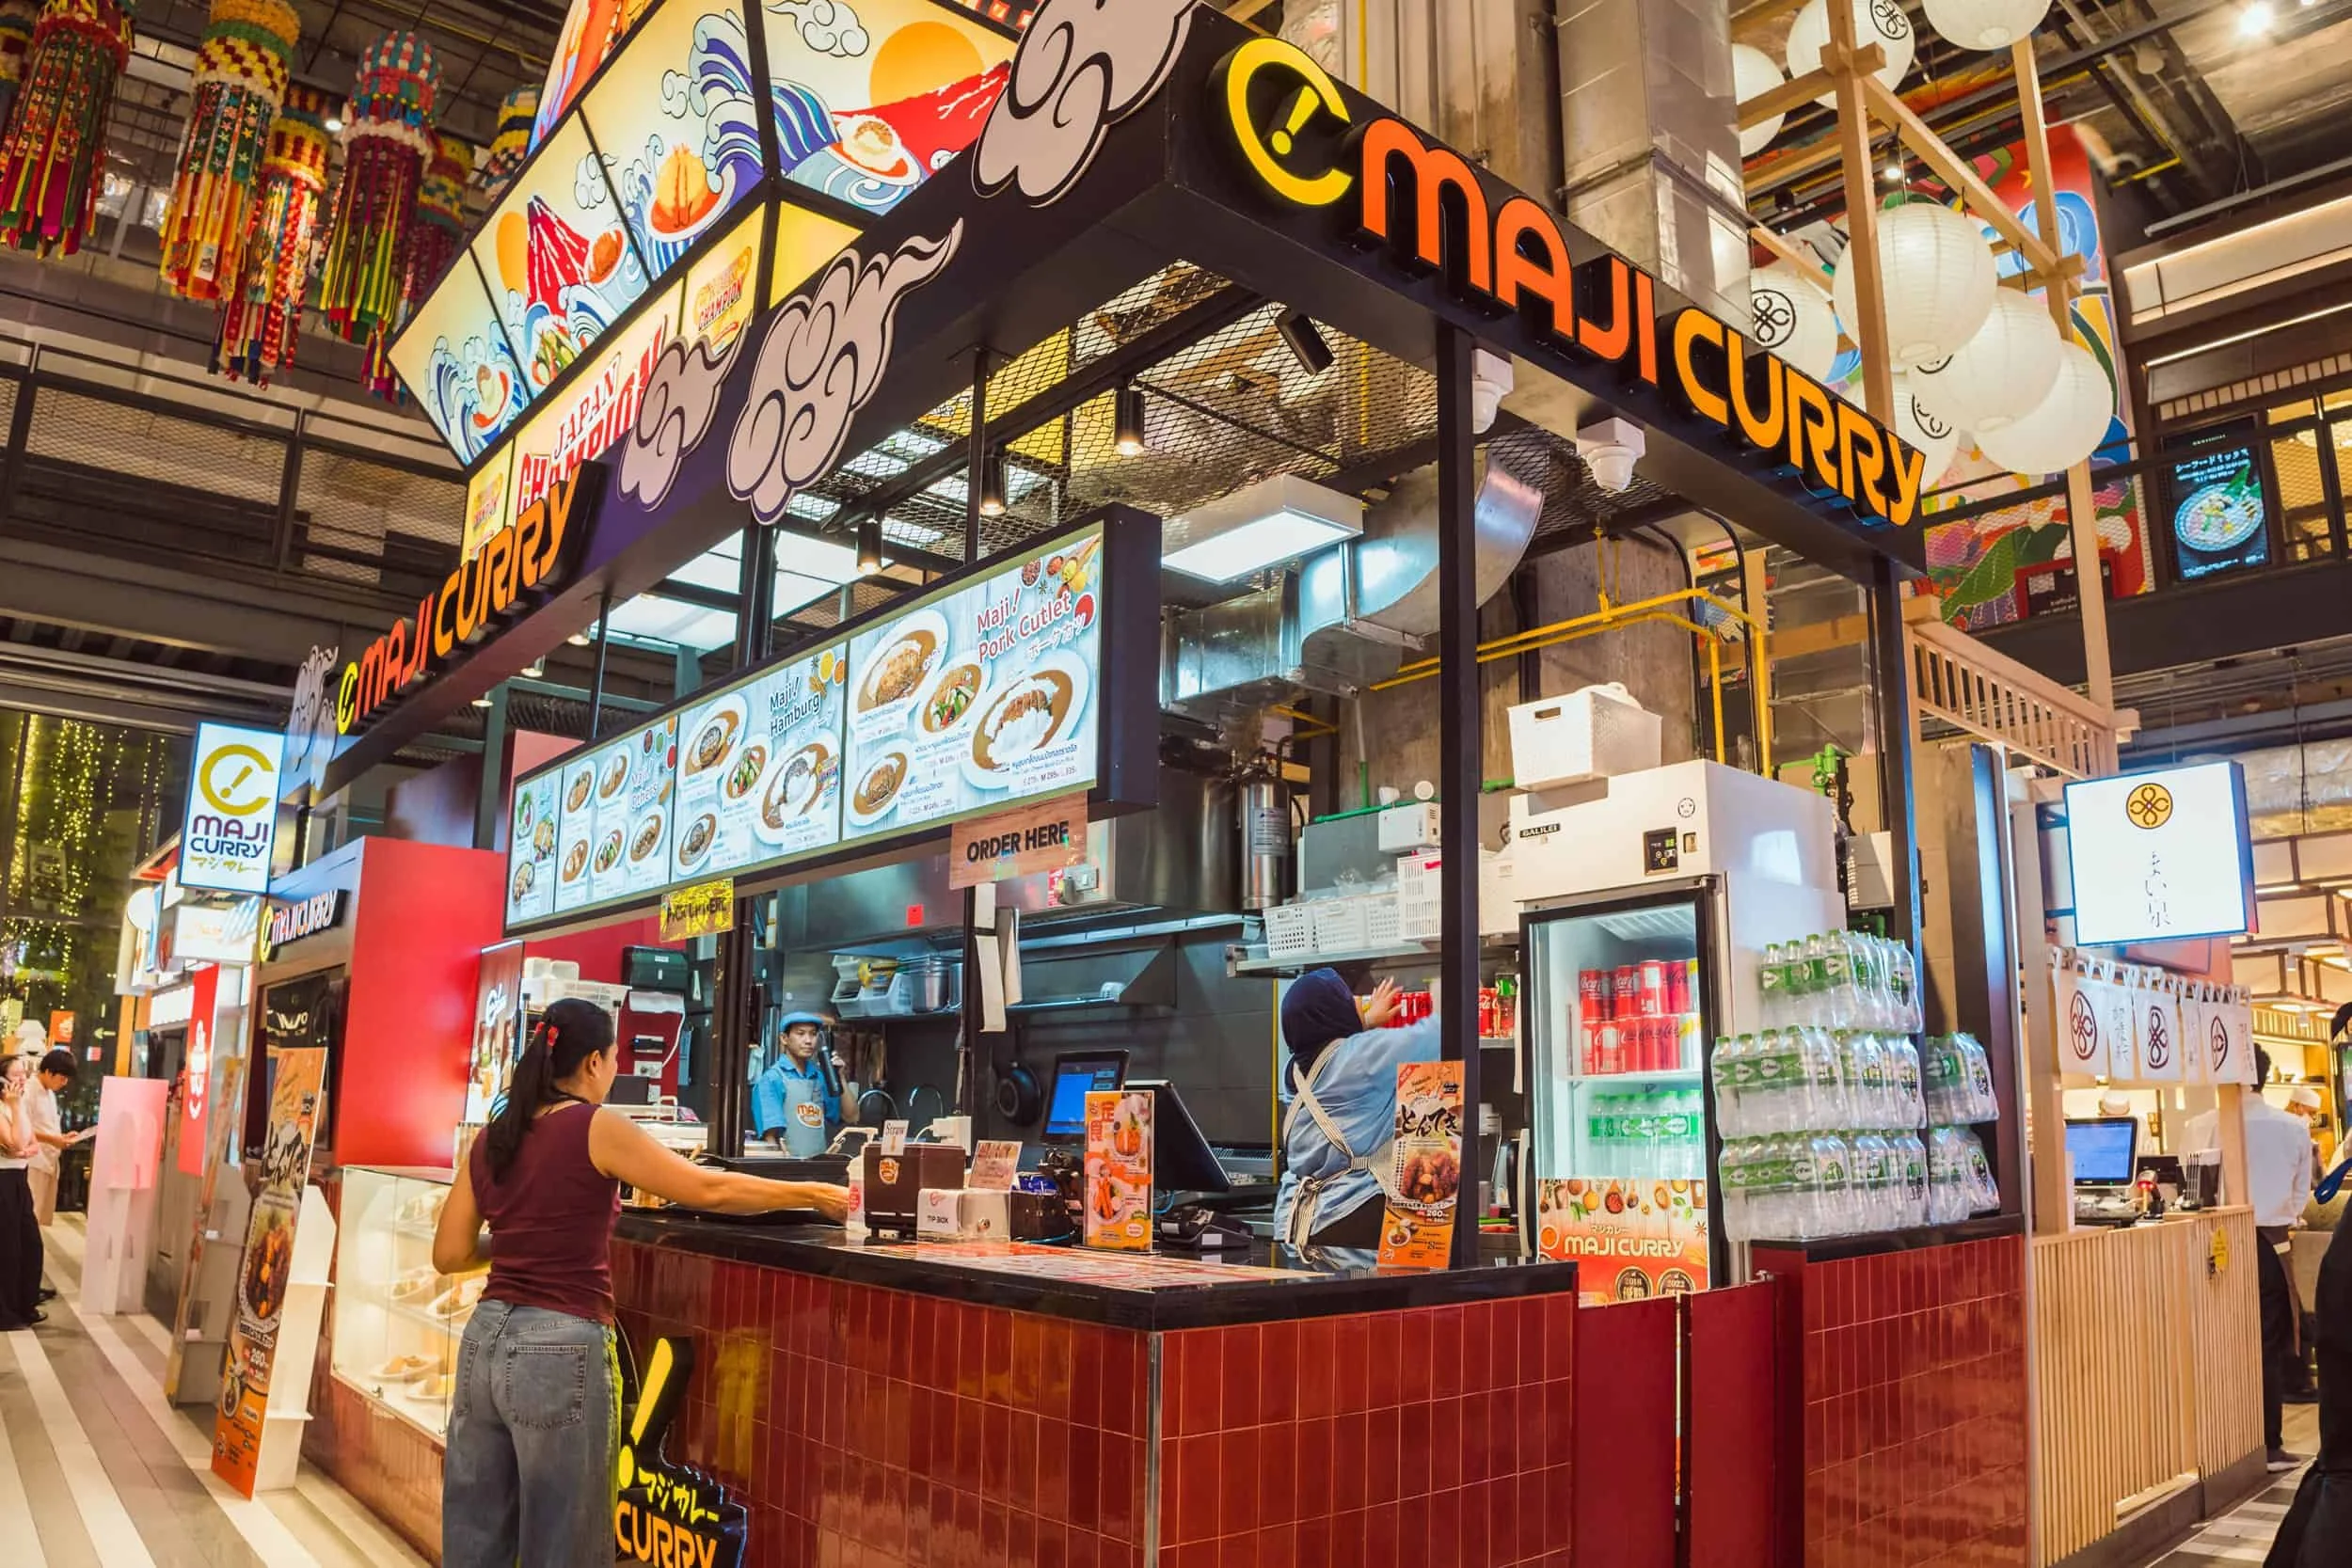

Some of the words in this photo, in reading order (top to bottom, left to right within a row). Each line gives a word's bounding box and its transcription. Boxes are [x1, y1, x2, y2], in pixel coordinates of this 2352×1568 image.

[1362, 118, 1658, 386] MAJI
[1674, 309, 1927, 527] CURRY
[553, 359, 618, 460] JAPAN
[355, 593, 435, 723] MAJI
[435, 461, 582, 657] CURRY
[978, 627, 1016, 663] Pork
[1019, 593, 1072, 637] Cutlet
[770, 692, 821, 737] Hamburg
[190, 837, 265, 858] CURRY
[192, 815, 269, 843] MAJI
[967, 832, 1022, 863] ORDER
[1025, 820, 1070, 851] HERE
[1565, 1235, 1614, 1256] MAJI
[1618, 1238, 1684, 1258] CURRY
[615, 1500, 718, 1568] CURRY
